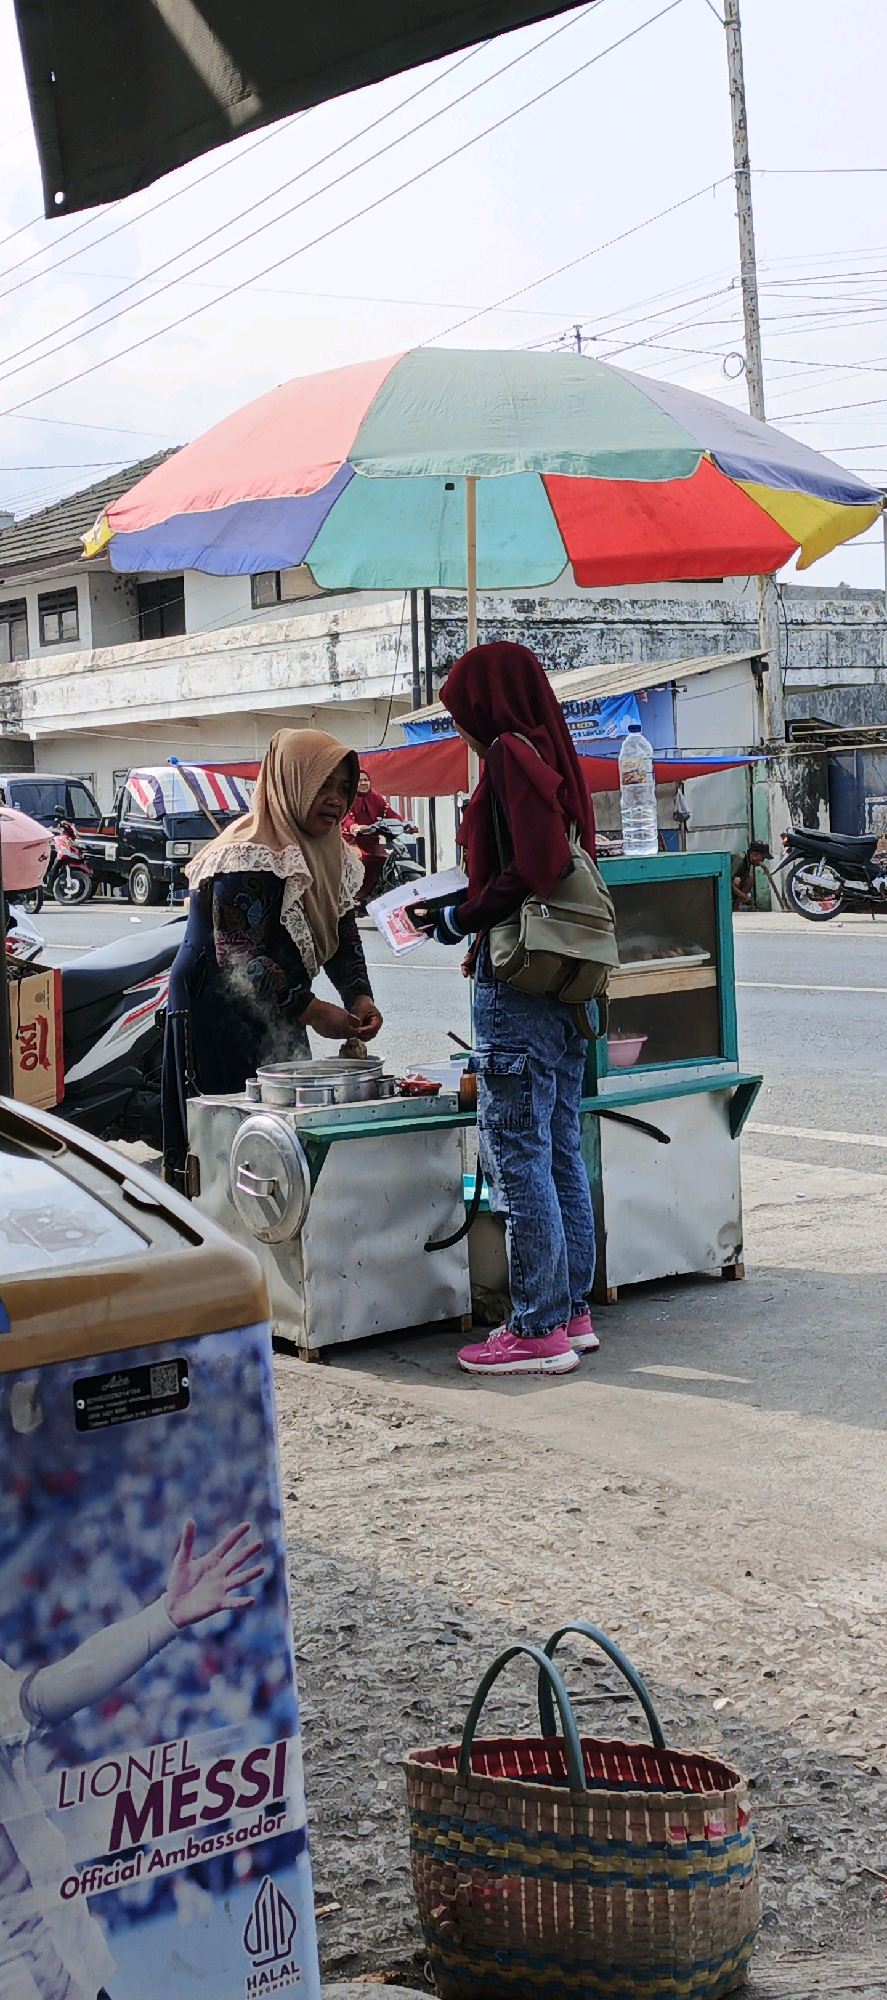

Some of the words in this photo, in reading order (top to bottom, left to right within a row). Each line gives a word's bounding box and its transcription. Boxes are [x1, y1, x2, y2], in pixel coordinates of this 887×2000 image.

[59, 1740, 195, 1808] LIONEL
[109, 1741, 287, 1852] MESSI
[60, 1854, 142, 1900] Official
[148, 1814, 287, 1873] Ambassador
[247, 1961, 300, 1990] HALAL
